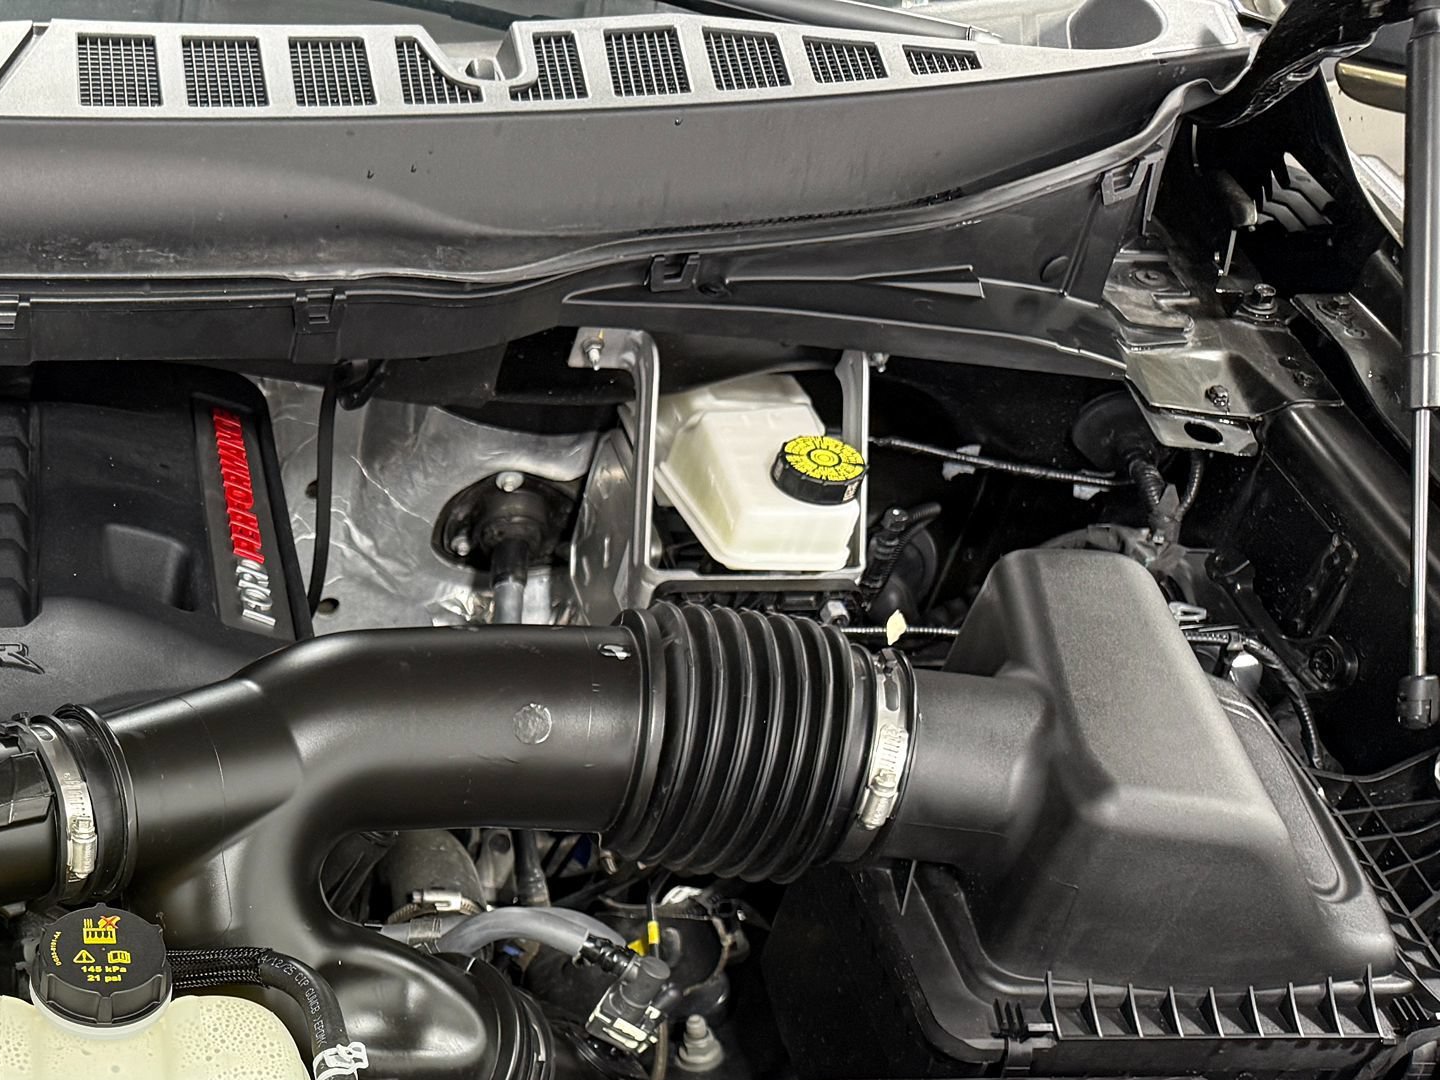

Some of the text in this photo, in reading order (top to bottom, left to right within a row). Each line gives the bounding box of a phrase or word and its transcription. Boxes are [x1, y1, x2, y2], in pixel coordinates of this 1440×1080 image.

[213, 408, 276, 627] FORD PERFORMANCE
[105, 965, 127, 973] kPa
[105, 974, 121, 983] psi
[294, 972, 310, 986] CIP
